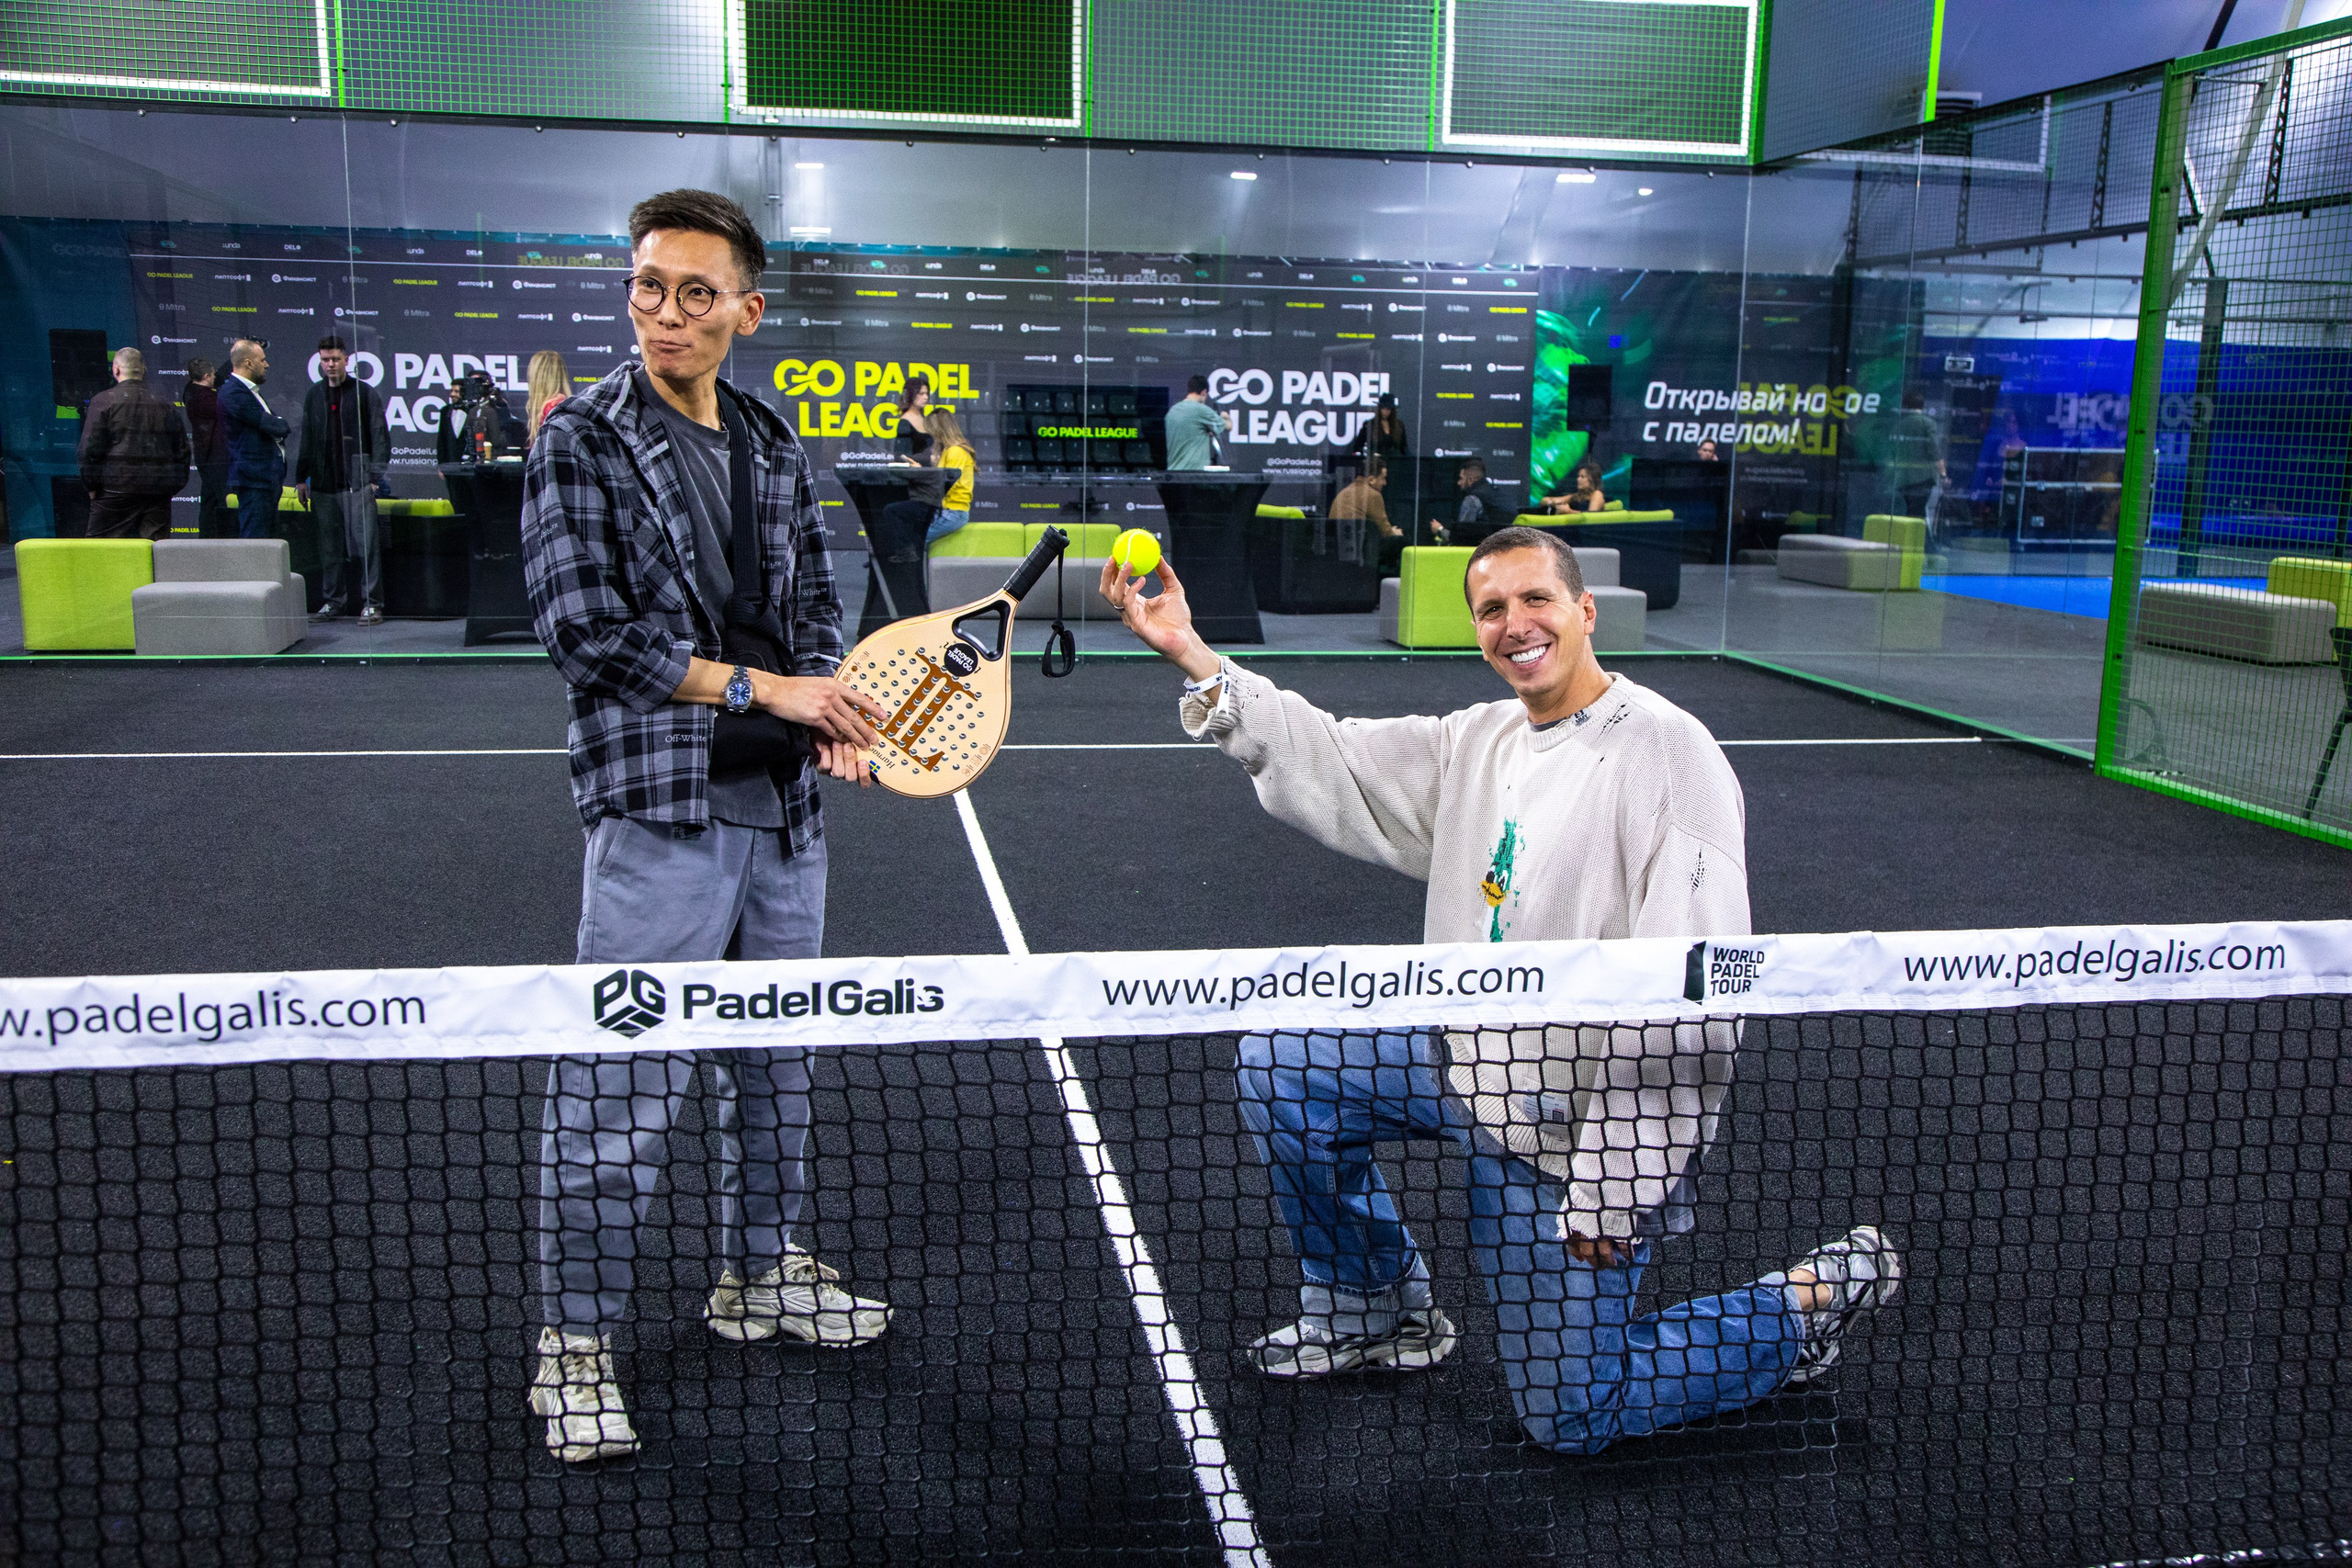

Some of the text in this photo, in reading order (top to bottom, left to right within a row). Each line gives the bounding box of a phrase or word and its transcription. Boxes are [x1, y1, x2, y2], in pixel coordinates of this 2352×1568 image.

[774, 358, 979, 399] GO PADEL
[1207, 367, 1399, 407] GO PADEL
[1644, 381, 1882, 415] Открывай ноое
[1038, 426, 1138, 438] GO PADEL LEAGUE
[1642, 418, 1802, 445] с паделом!
[664, 734, 707, 743] Off-White
[1713, 947, 1765, 964] WORLD
[1904, 939, 2286, 987] www.padelgalis.com
[1102, 961, 1545, 1010] www.padelgalis.com
[1711, 963, 1760, 979] PADEL
[683, 978, 944, 1020] PadelGalis
[1710, 978, 1752, 997] TOUR
